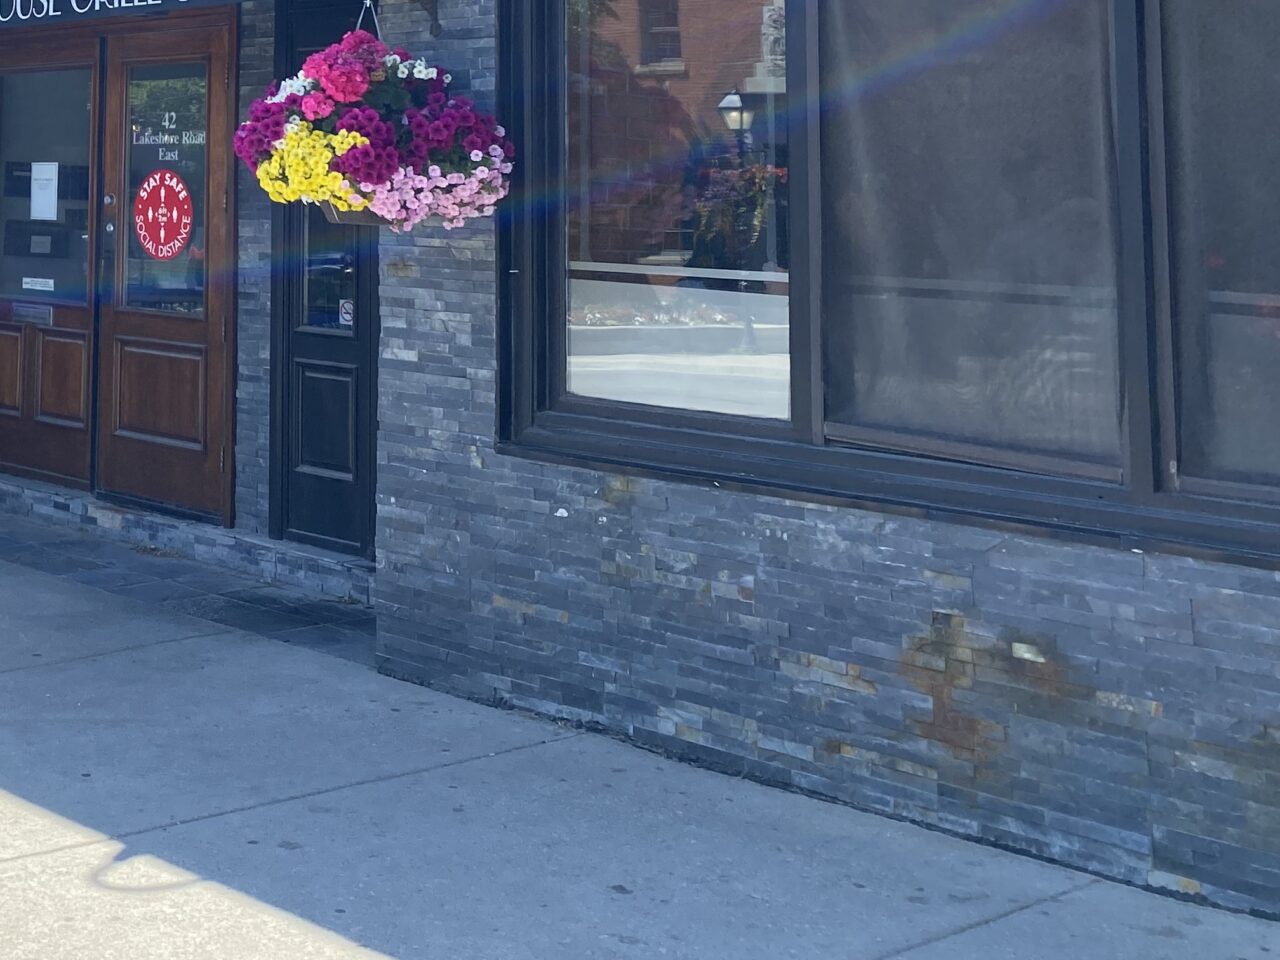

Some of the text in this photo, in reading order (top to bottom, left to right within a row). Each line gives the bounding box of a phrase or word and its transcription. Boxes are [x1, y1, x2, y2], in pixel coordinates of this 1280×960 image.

[161, 111, 177, 129] 42
[132, 131, 206, 145] Lakeshore Road
[158, 147, 179, 161] East
[139, 173, 188, 201] STAY SAFE
[135, 215, 192, 257] SOCIAL DISTANCE
